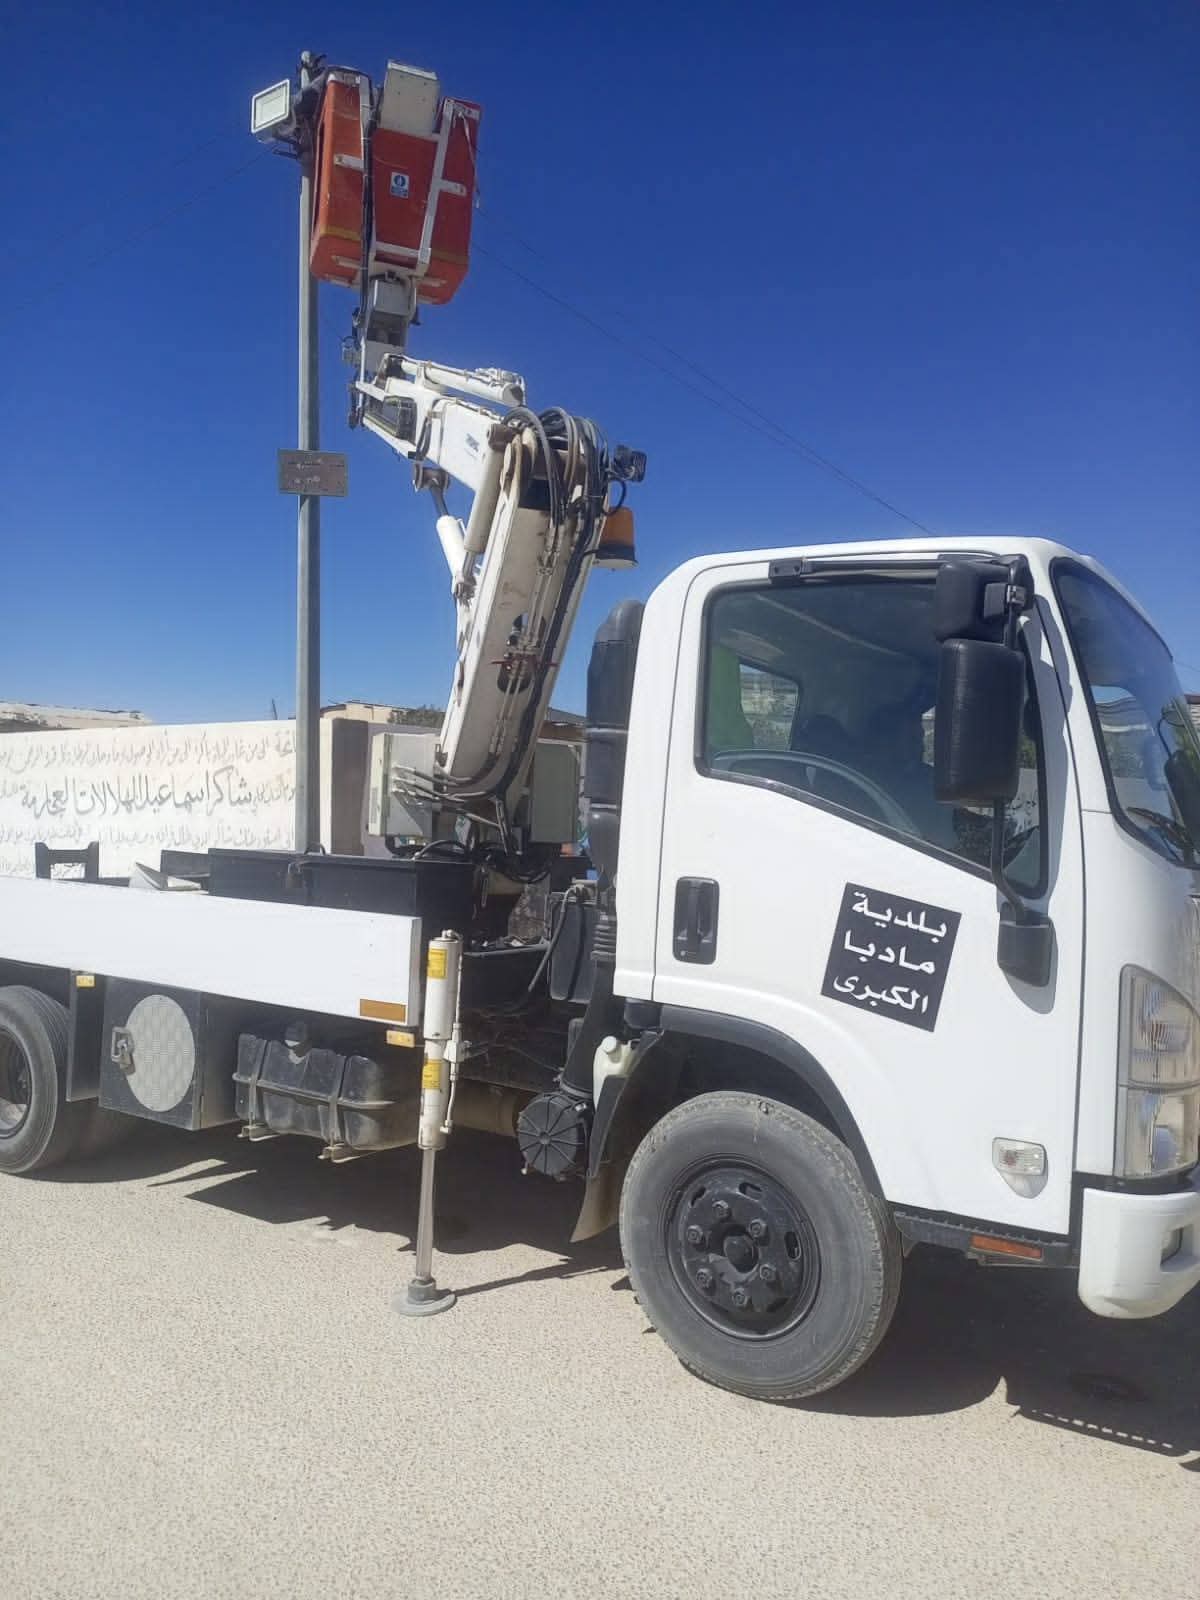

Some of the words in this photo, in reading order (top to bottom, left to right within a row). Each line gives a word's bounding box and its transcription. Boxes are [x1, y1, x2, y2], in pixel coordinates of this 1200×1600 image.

[852, 891, 947, 943] بلدية
[844, 930, 936, 974] مادبا
[833, 976, 929, 1013] الكبرى
